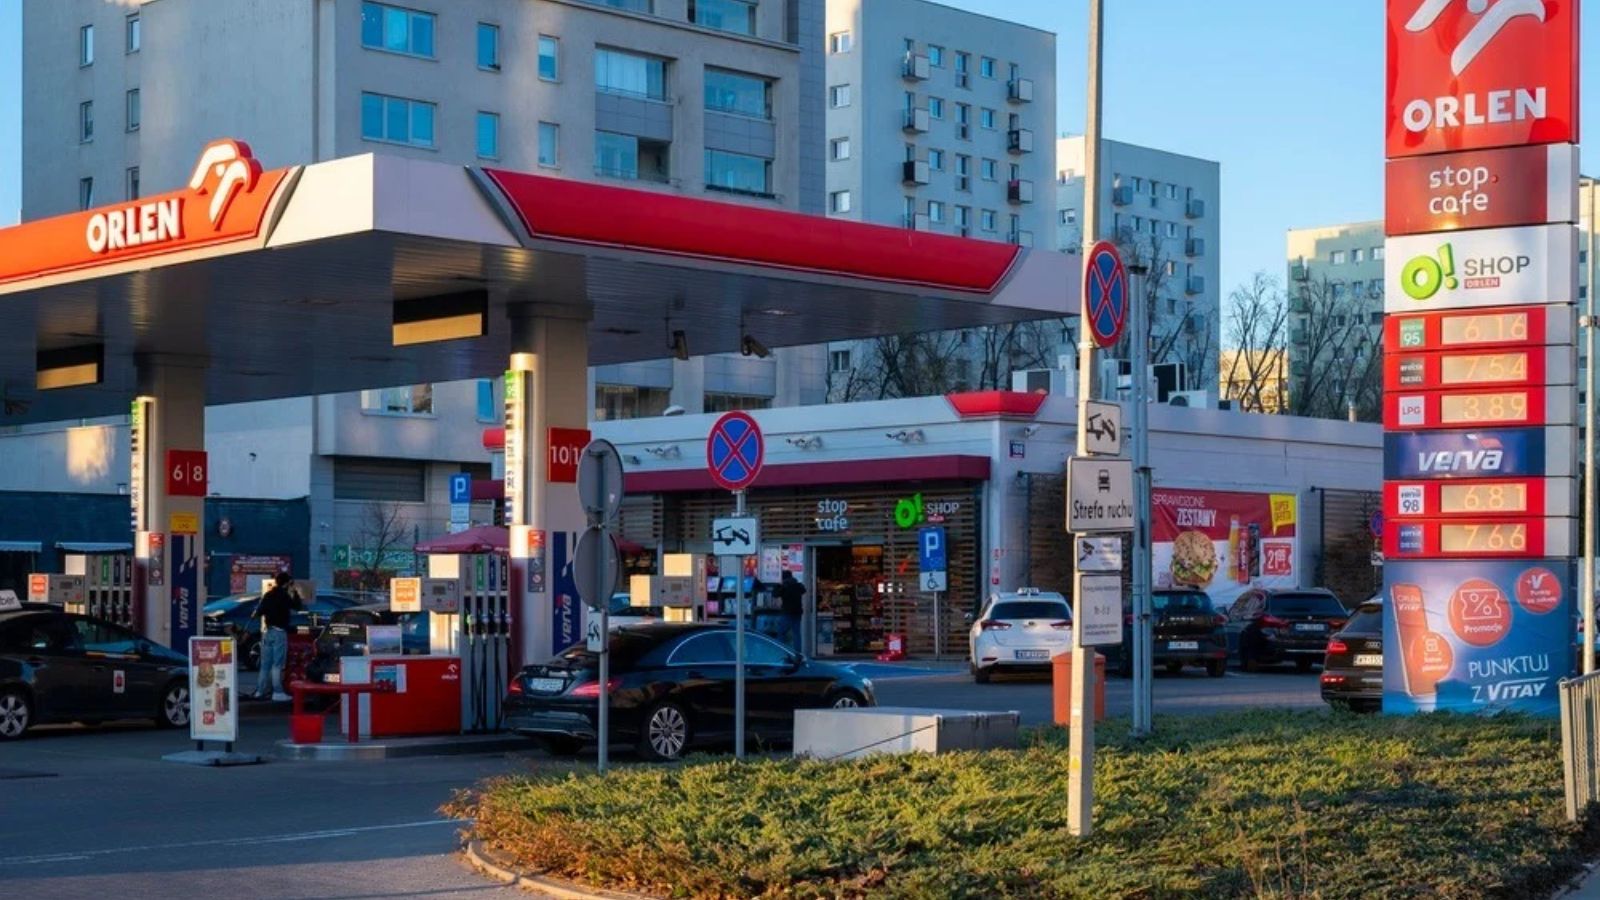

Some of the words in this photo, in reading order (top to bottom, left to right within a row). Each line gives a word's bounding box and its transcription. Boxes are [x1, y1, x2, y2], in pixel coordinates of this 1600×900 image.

[1402, 87, 1547, 133] ORLEN
[1429, 166, 1489, 191] stop
[1429, 190, 1489, 215] cafe
[87, 197, 181, 253] ORLEN
[1463, 255, 1531, 277] SHOP
[1466, 277, 1499, 289] ORLEN
[1403, 332, 1420, 345] 95
[1402, 404, 1421, 416] LPG
[551, 446, 568, 465] 10
[1418, 449, 1504, 472] verva
[172, 464, 183, 481] 6
[192, 465, 203, 482] 8
[455, 477, 466, 500] P
[817, 499, 848, 515] stop
[927, 502, 960, 514] SHOP
[1073, 500, 1104, 519] Strefa
[1107, 499, 1133, 519] ruchu
[1402, 499, 1420, 513] 98
[817, 516, 848, 531] cafe
[1177, 508, 1217, 527] ZESTAWY
[925, 532, 940, 558] P
[180, 586, 189, 629] verva
[562, 593, 572, 644] verva
[1468, 654, 1549, 678] PUNKTUJ
[1471, 686, 1484, 703] Z
[1487, 677, 1549, 702] VITAY
